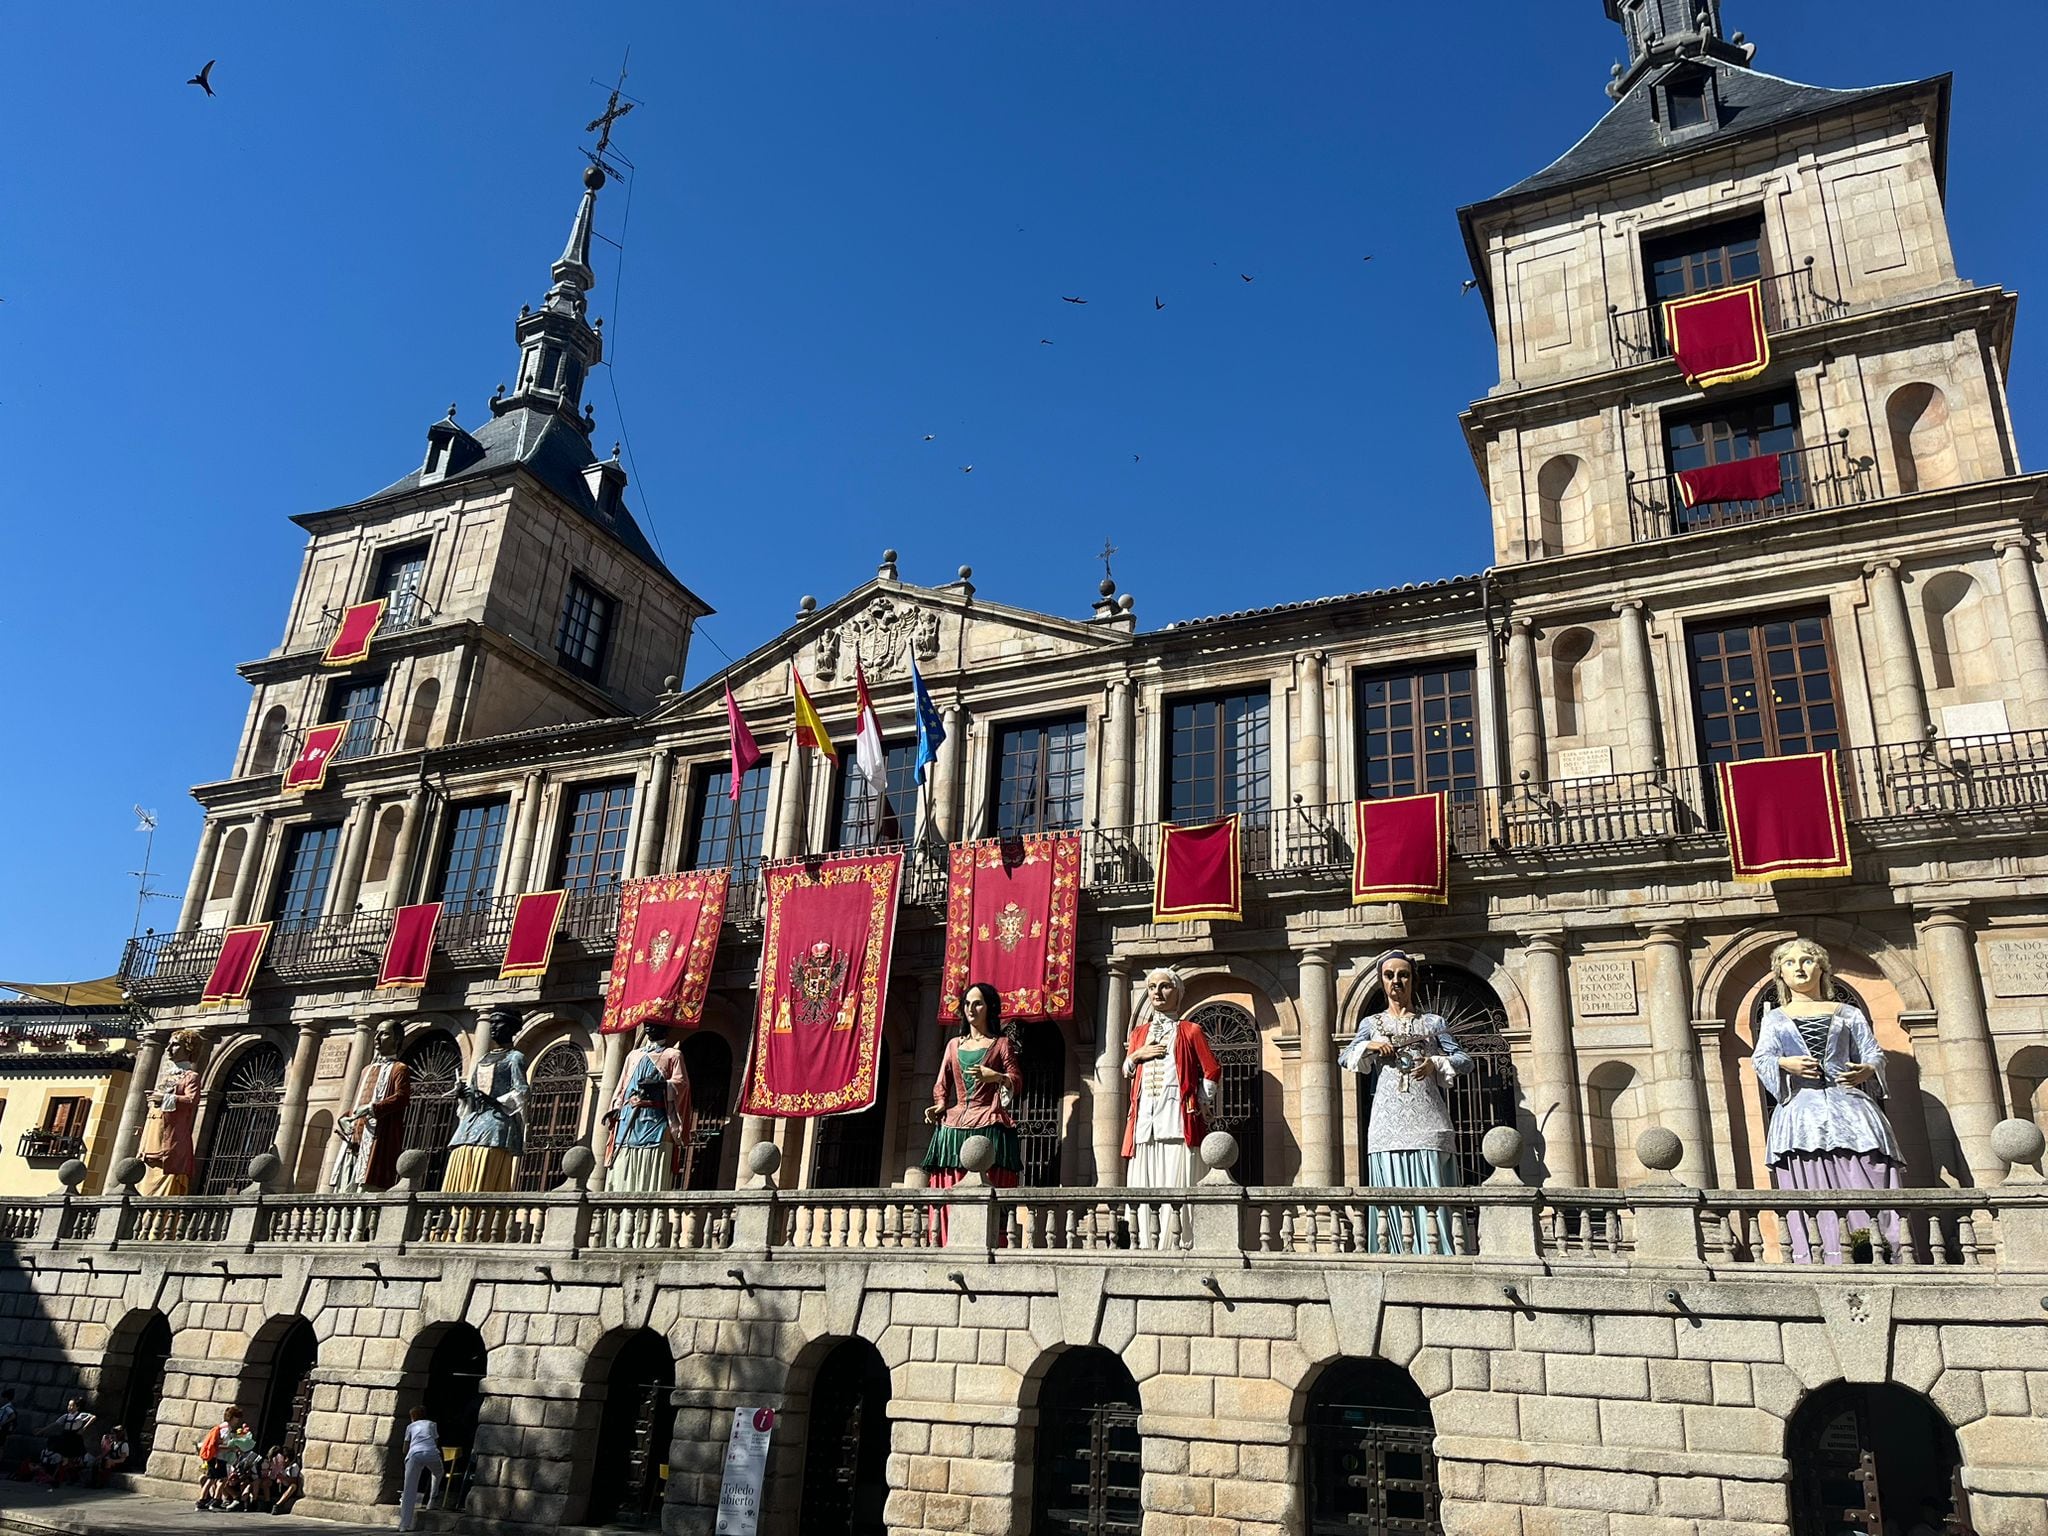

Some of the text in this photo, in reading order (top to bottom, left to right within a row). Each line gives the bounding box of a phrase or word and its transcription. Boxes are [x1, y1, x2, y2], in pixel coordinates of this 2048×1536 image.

[1585, 972, 1625, 982] ACABAR
[1581, 991, 1632, 1002] REINANDO
[723, 1483, 754, 1495] Toledo
[721, 1494, 754, 1506] abierto
